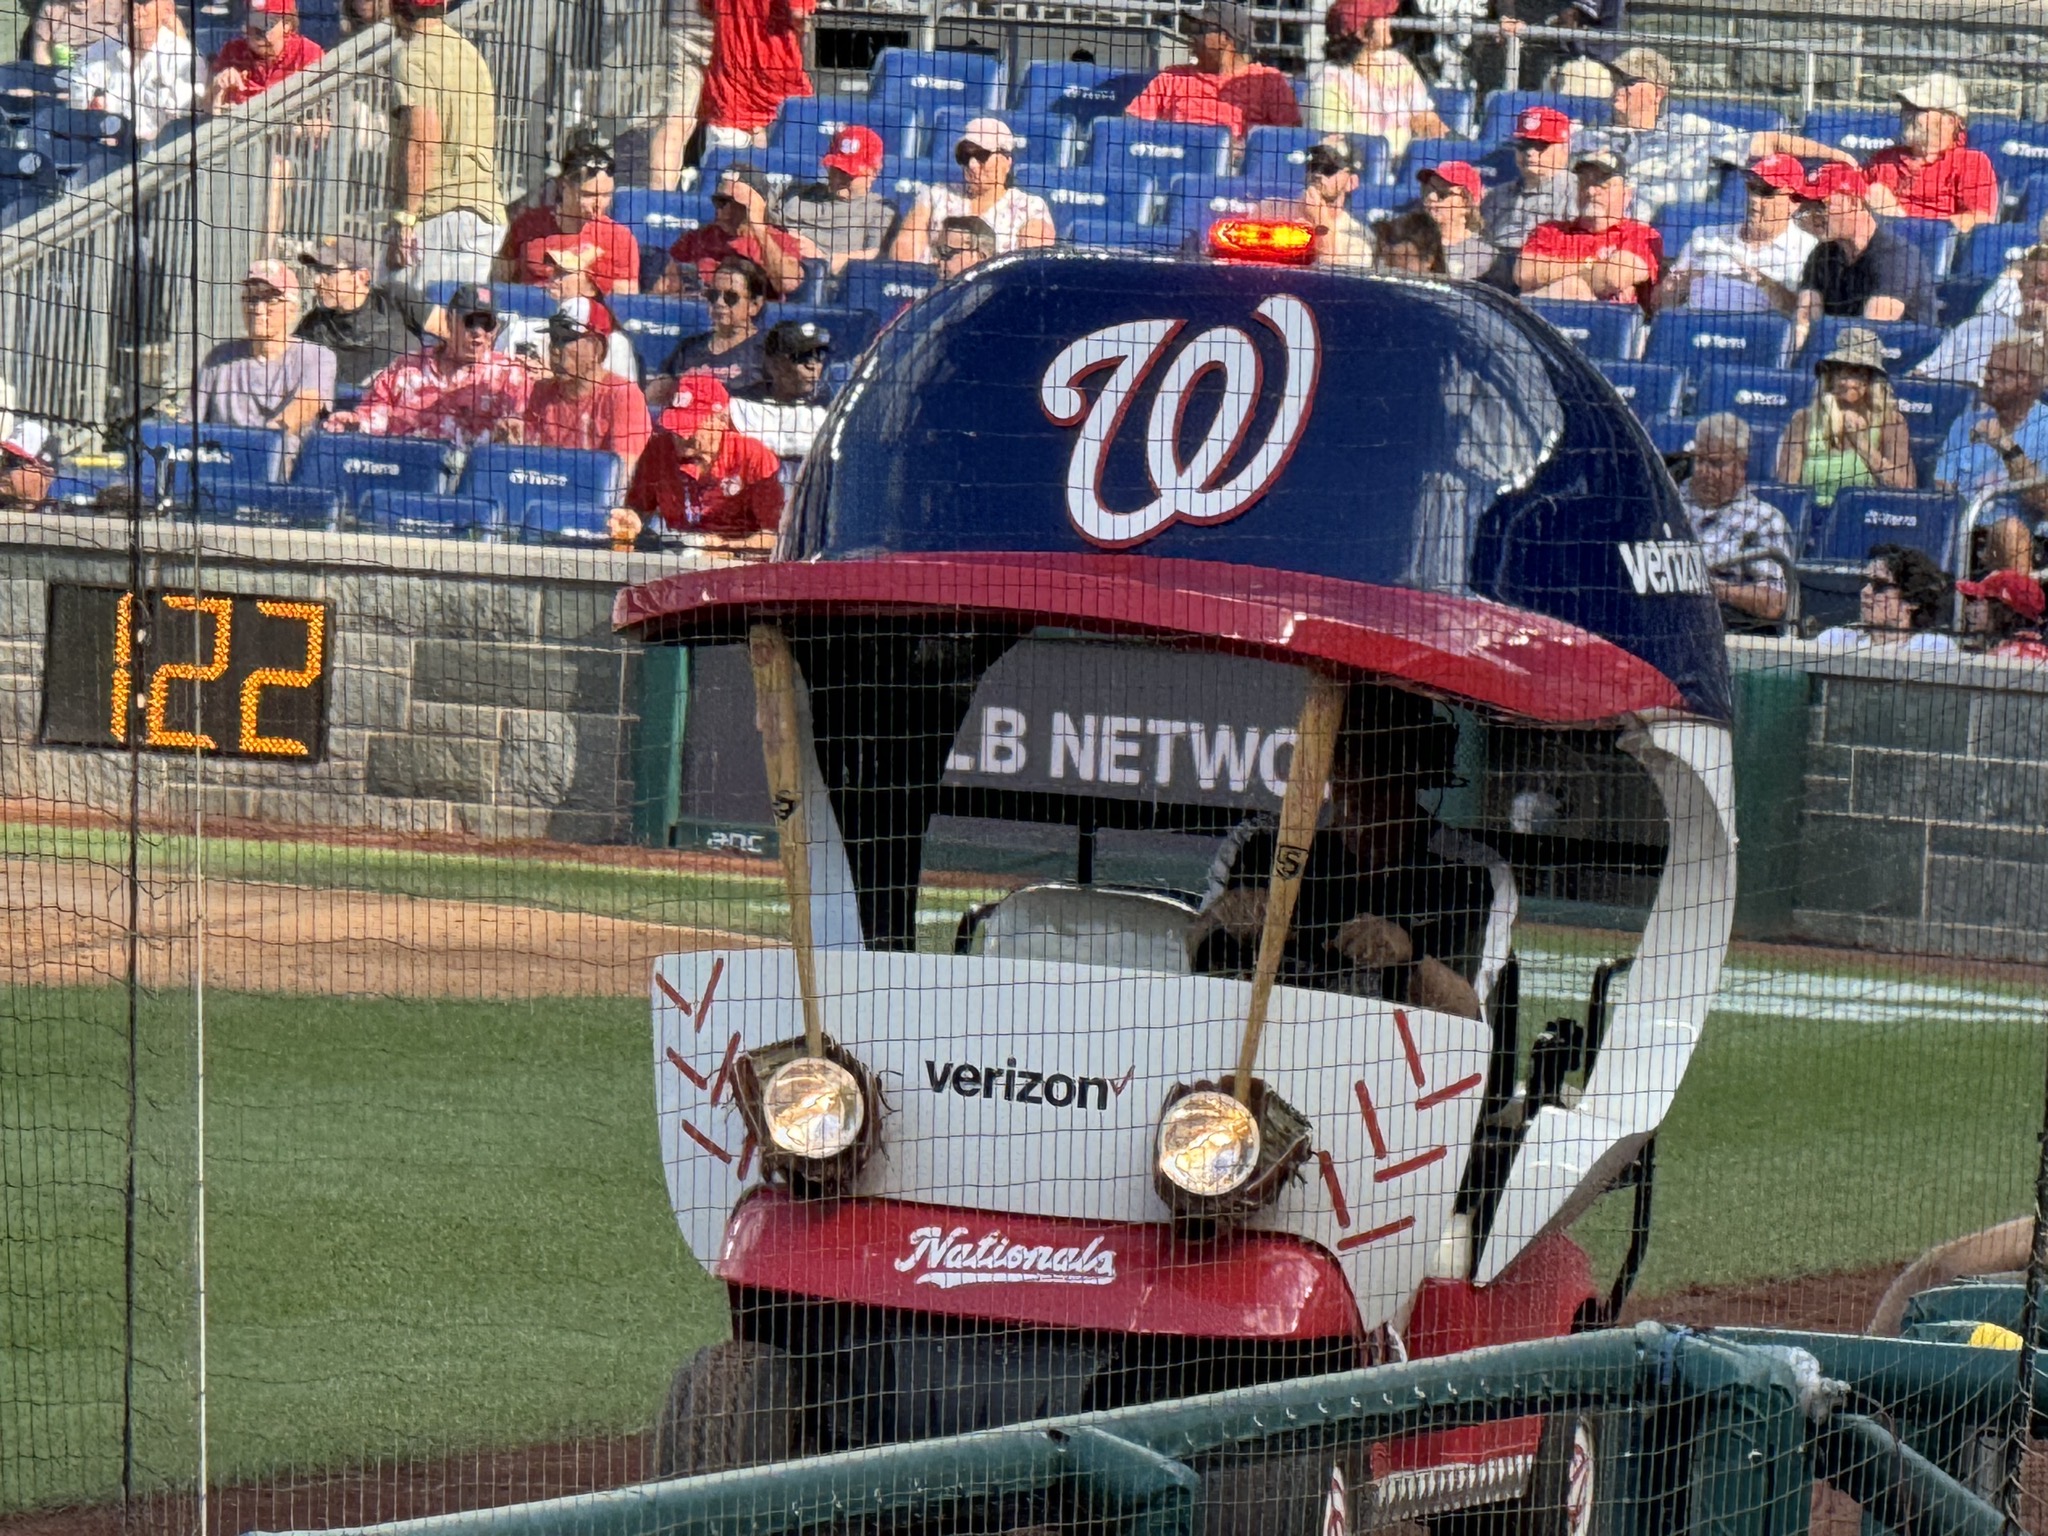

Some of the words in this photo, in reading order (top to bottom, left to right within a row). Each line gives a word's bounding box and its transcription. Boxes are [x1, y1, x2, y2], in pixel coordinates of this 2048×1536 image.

[1040, 292, 1322, 549] W
[925, 1055, 1108, 1111] verizon
[894, 1226, 1117, 1281] Nationals
